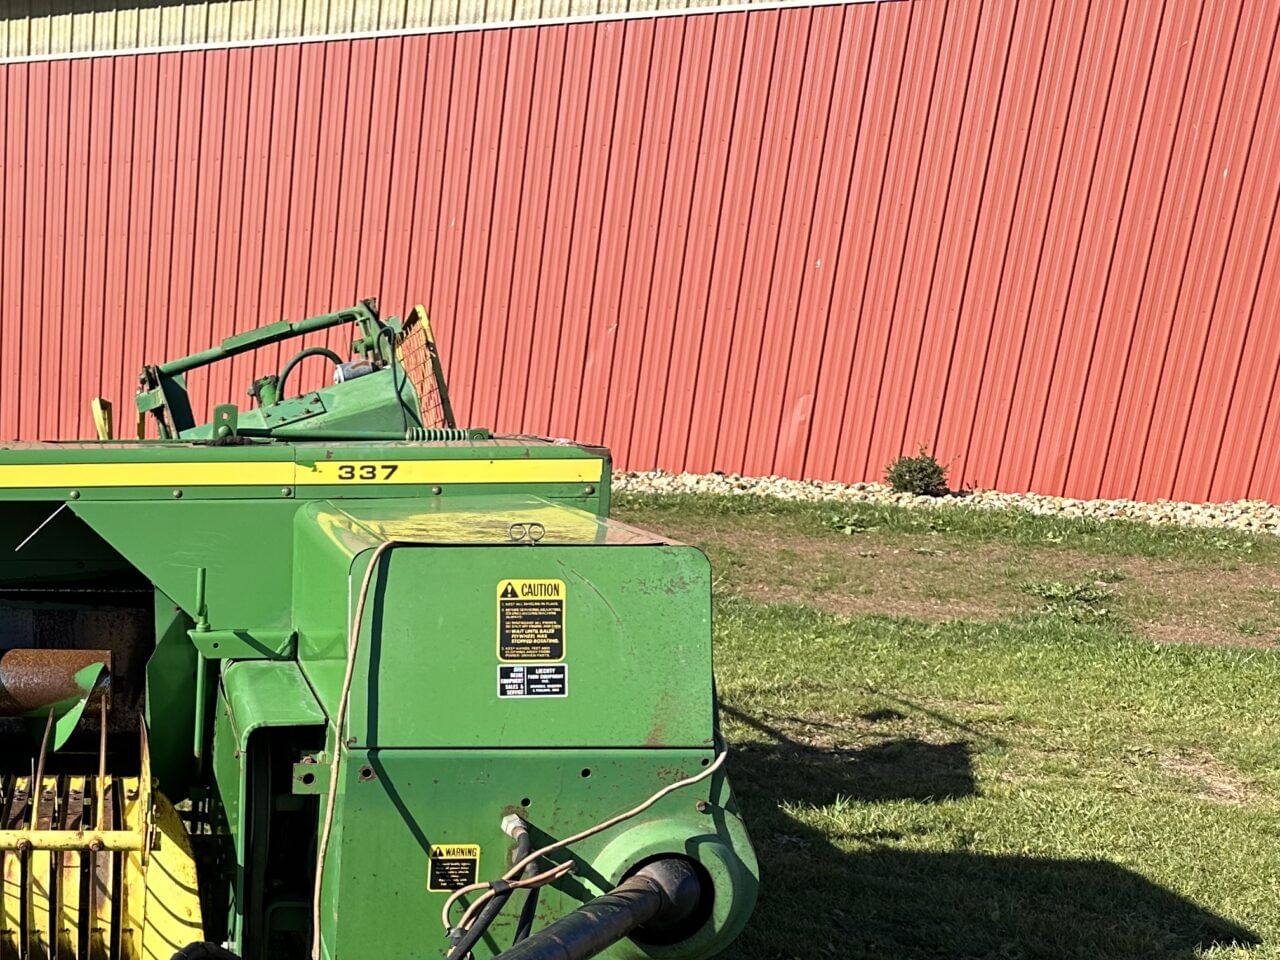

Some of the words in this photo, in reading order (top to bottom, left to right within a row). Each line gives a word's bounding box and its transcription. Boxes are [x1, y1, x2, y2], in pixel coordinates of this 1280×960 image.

[338, 464, 399, 480] 337
[521, 583, 560, 597] CAUTION
[445, 847, 477, 857] WARNING
